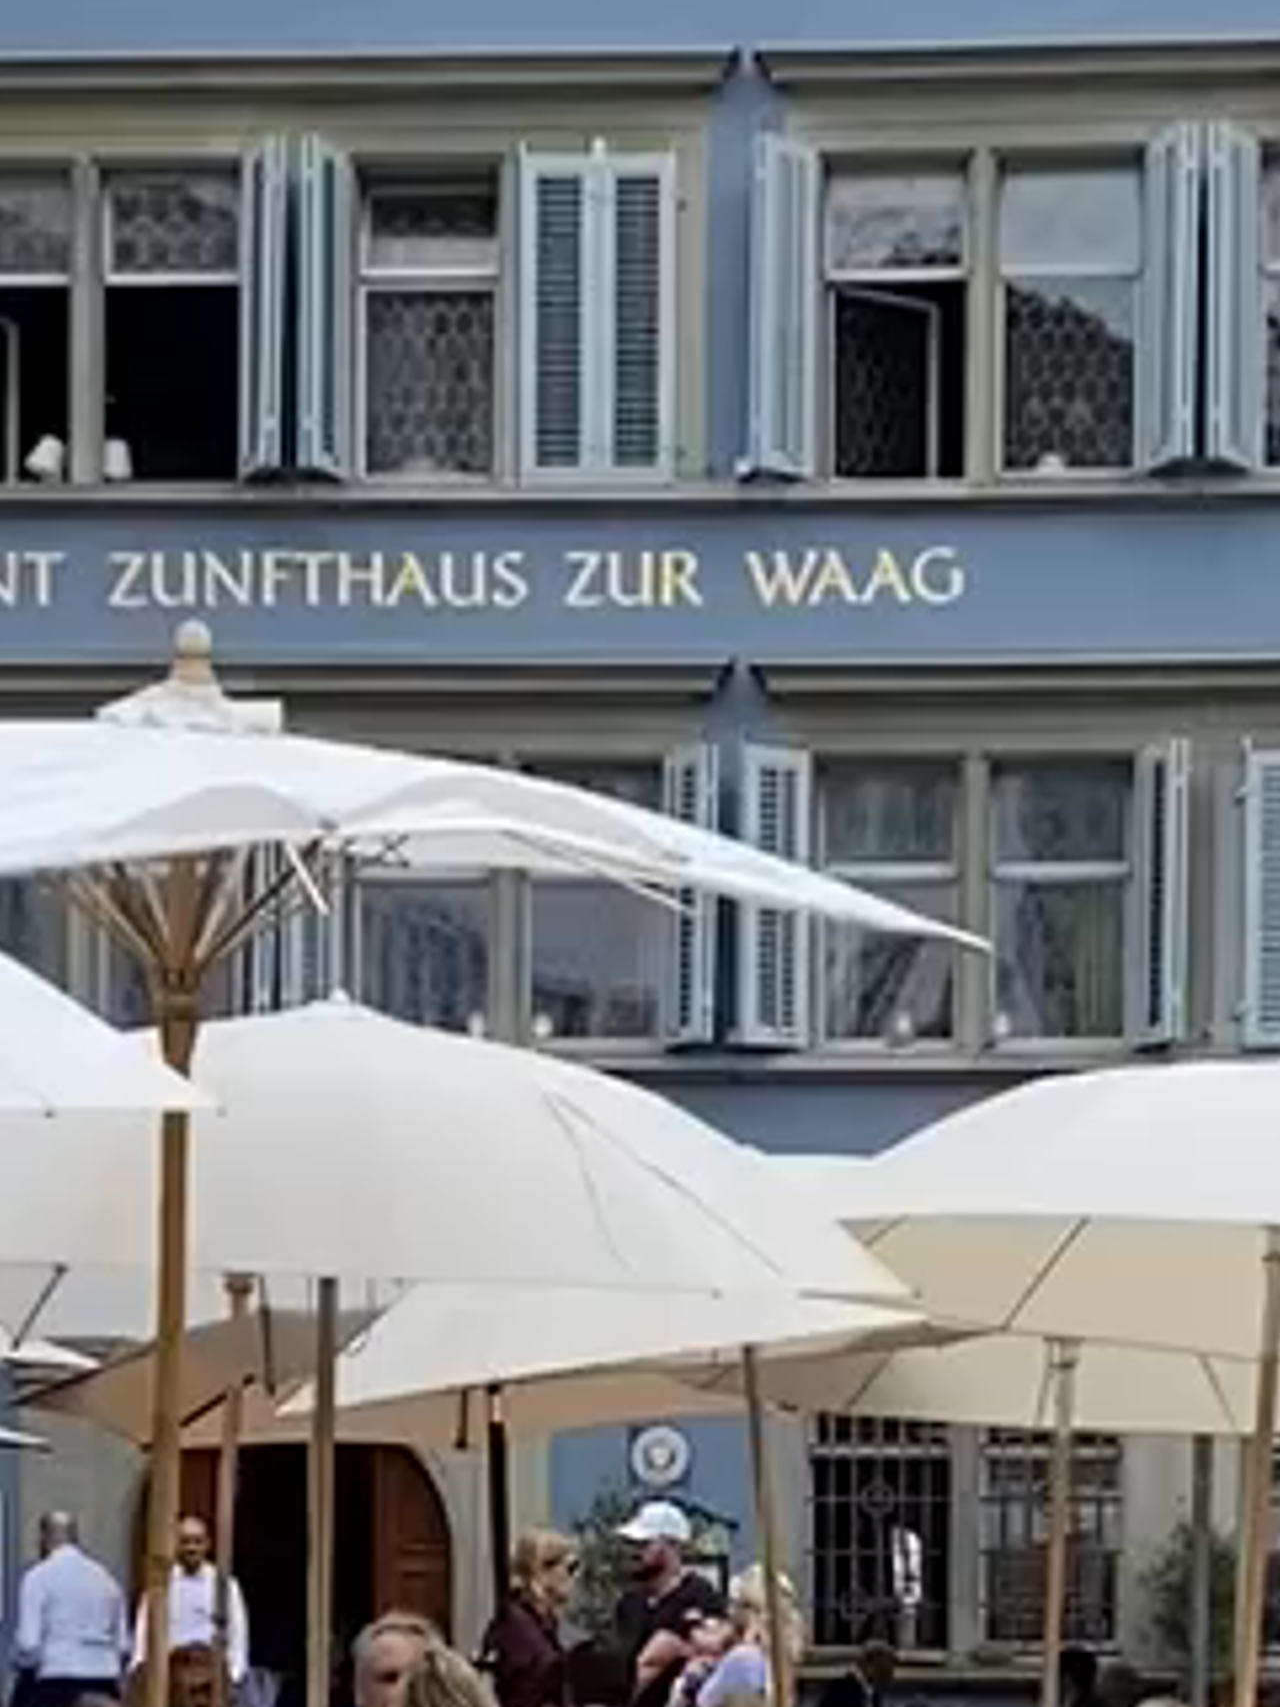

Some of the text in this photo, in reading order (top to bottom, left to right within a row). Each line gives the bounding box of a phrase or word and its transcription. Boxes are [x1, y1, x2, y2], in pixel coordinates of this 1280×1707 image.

[108, 550, 529, 606] ZUNFTHAUS
[564, 550, 704, 606] ZUR
[747, 547, 965, 605] WAAG
